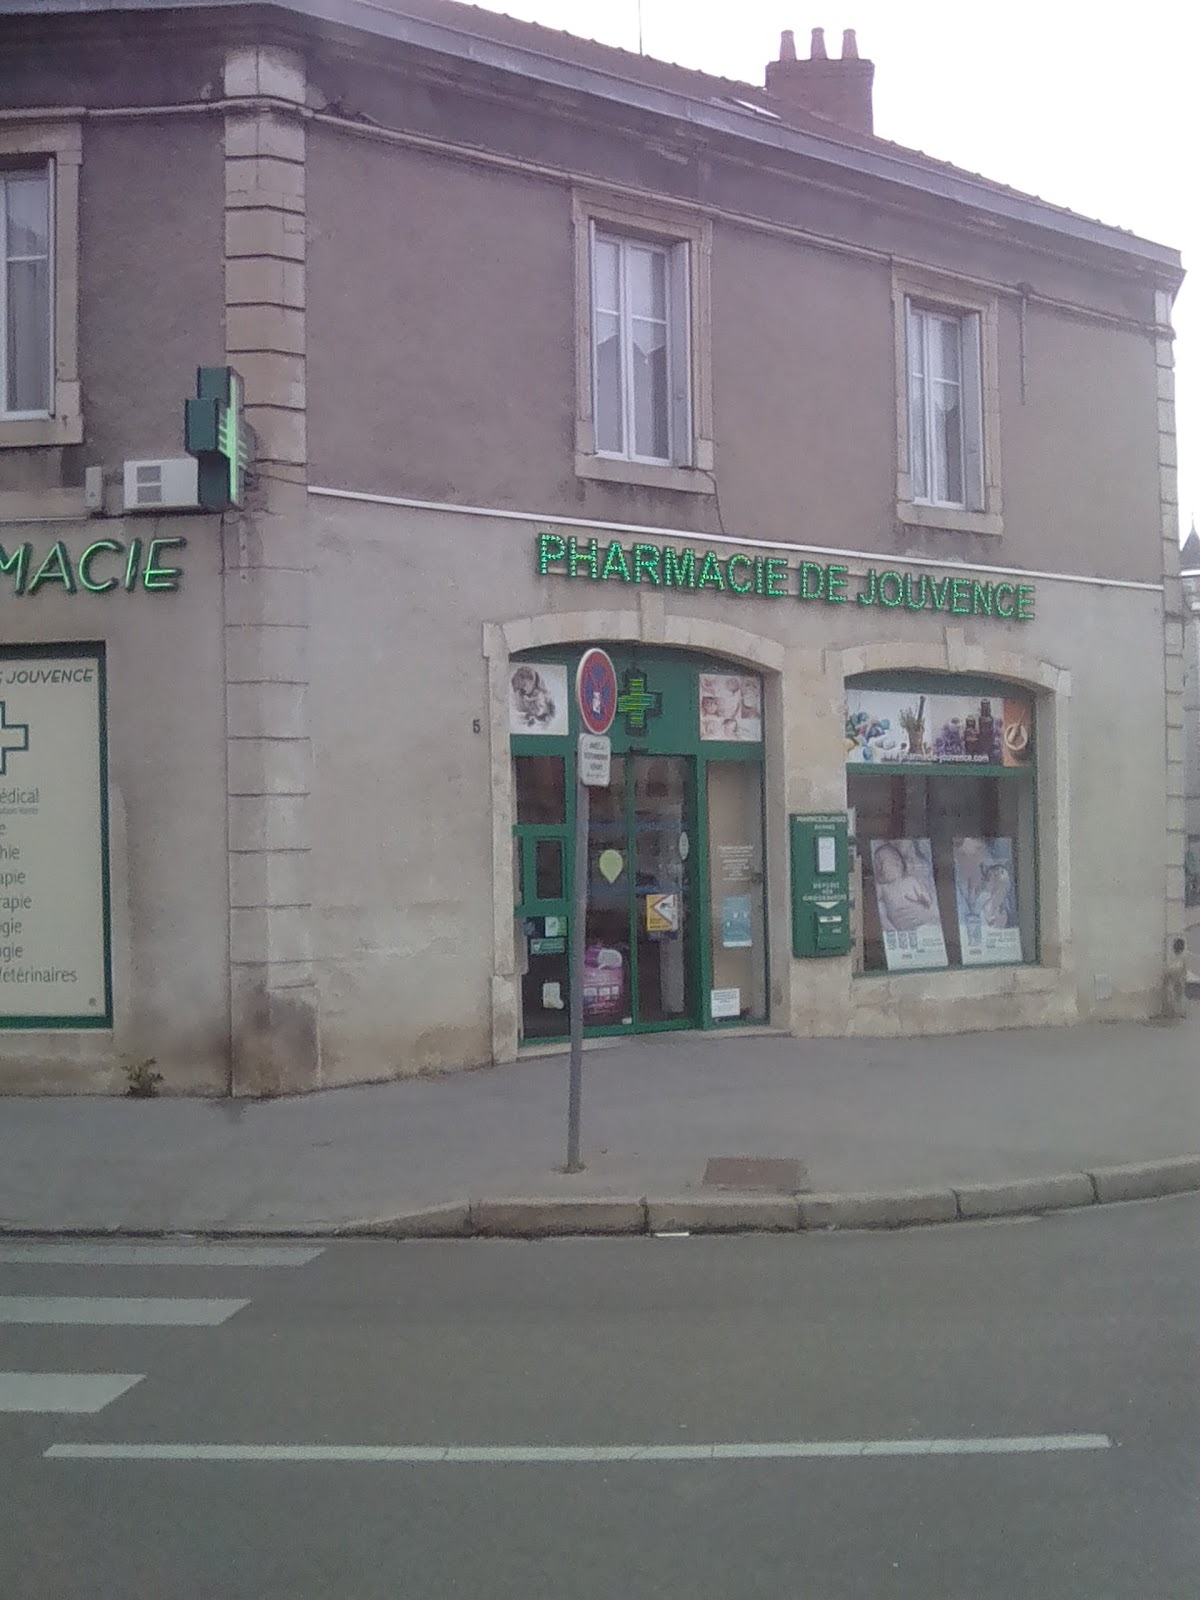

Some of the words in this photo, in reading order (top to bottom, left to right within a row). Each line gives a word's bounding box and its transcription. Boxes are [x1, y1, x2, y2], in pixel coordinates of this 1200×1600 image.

[538, 533, 789, 597] PHARMACIE
[800, 560, 848, 603] DE
[857, 568, 1036, 622] JOUVENCE
[6, 668, 94, 684] JOUVENCE
